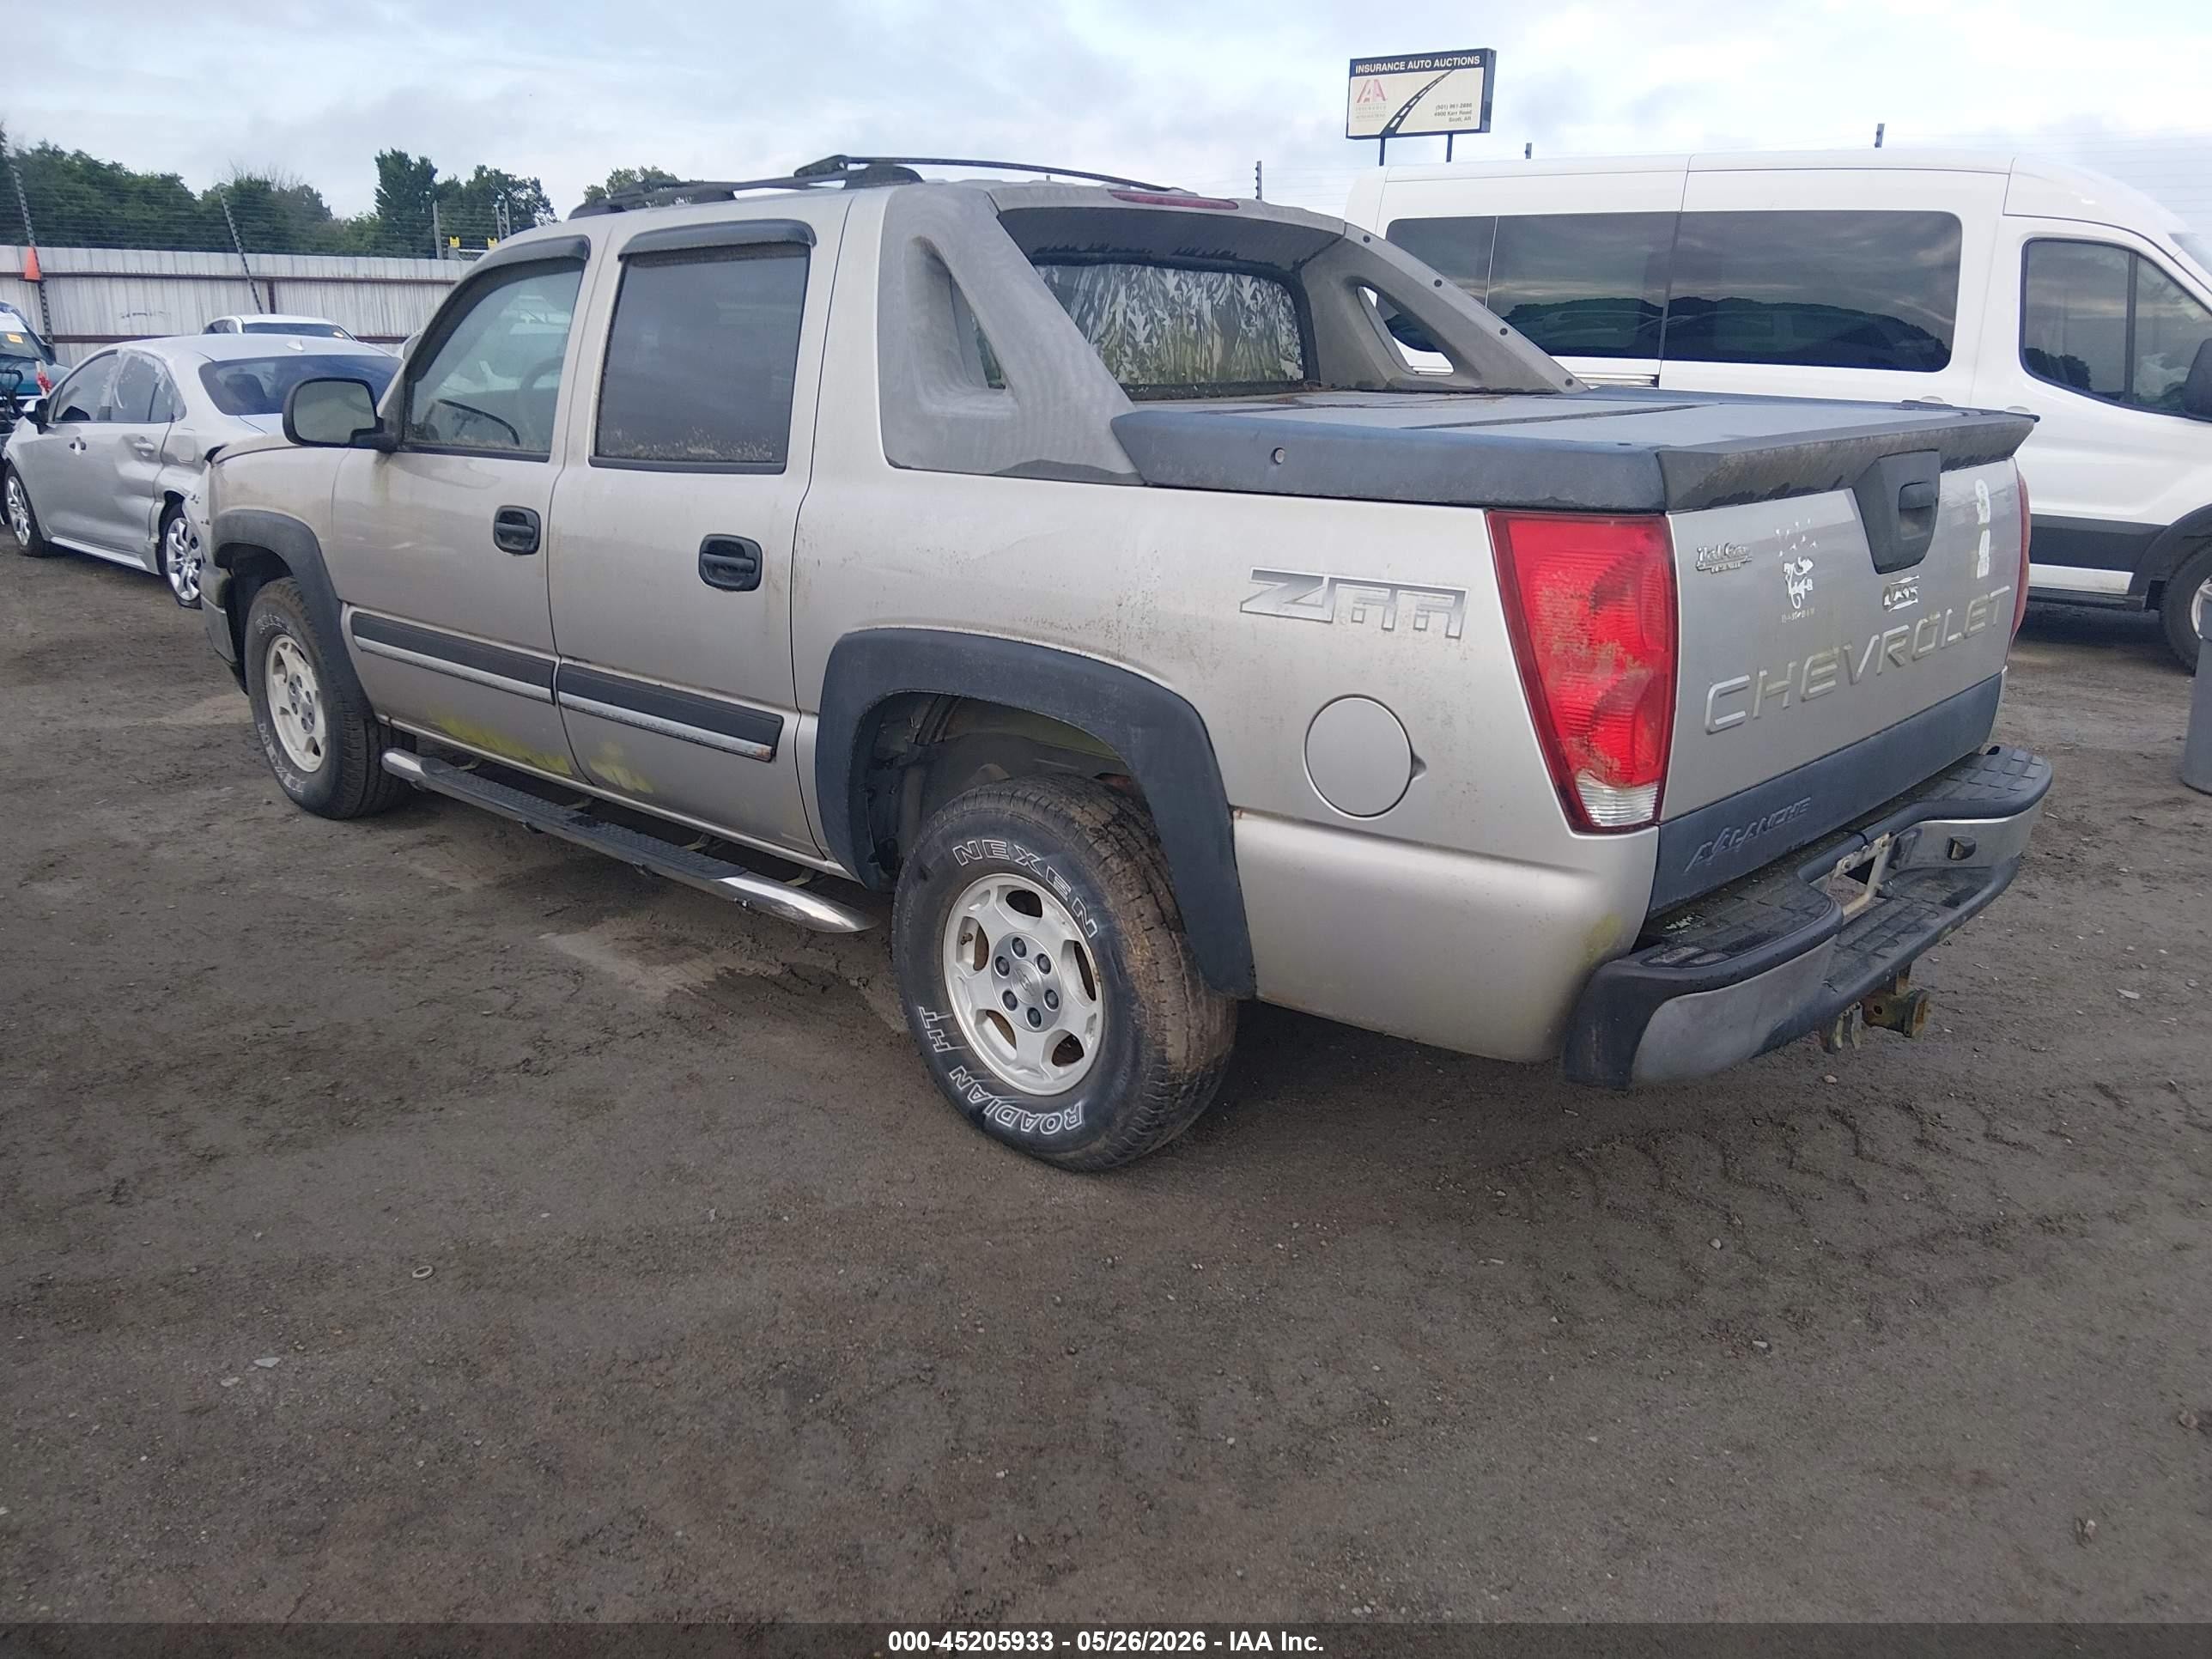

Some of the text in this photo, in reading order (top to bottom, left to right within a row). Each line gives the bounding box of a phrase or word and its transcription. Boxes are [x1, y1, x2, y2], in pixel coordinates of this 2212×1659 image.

[1356, 56, 1480, 74] INSURANCE AUTO AUCTIONS
[1705, 585, 2011, 735] CHEVROLET
[952, 838, 1098, 939] NEXEN
[918, 1006, 1085, 1135] ROADIAN HT
